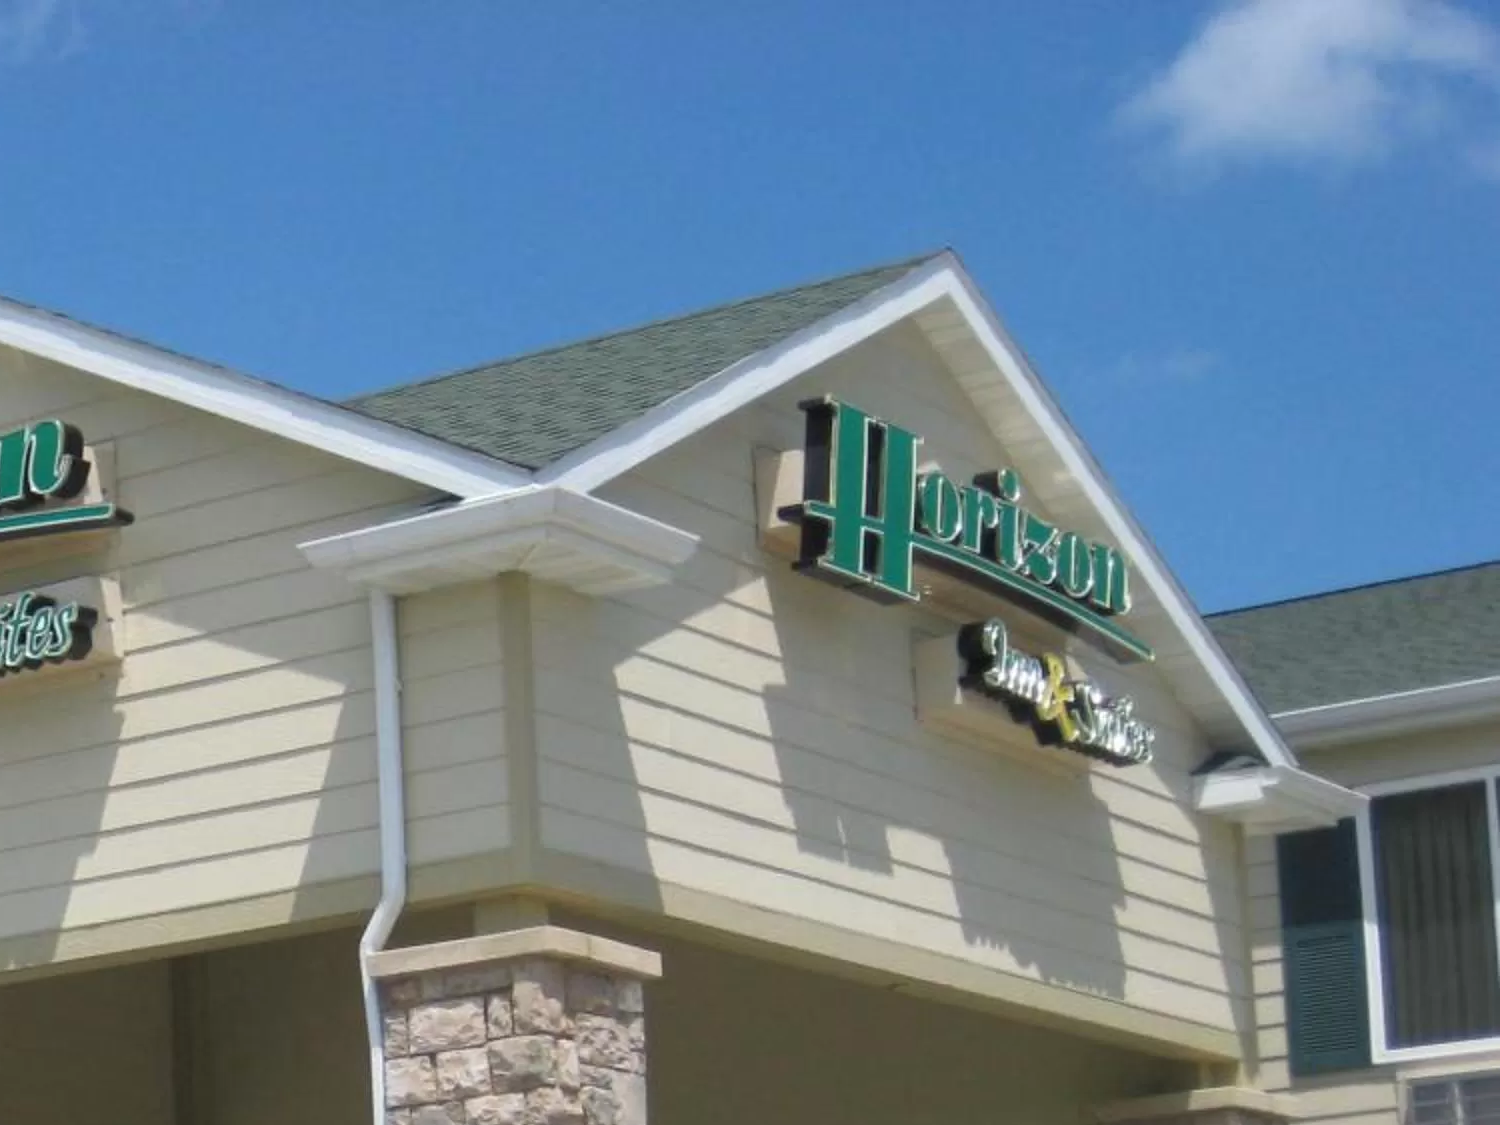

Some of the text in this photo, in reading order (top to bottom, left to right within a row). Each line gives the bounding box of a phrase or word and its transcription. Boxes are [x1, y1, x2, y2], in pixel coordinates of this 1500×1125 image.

[803, 394, 1135, 617] Horizon
[983, 617, 1156, 765] Inn & Suites
